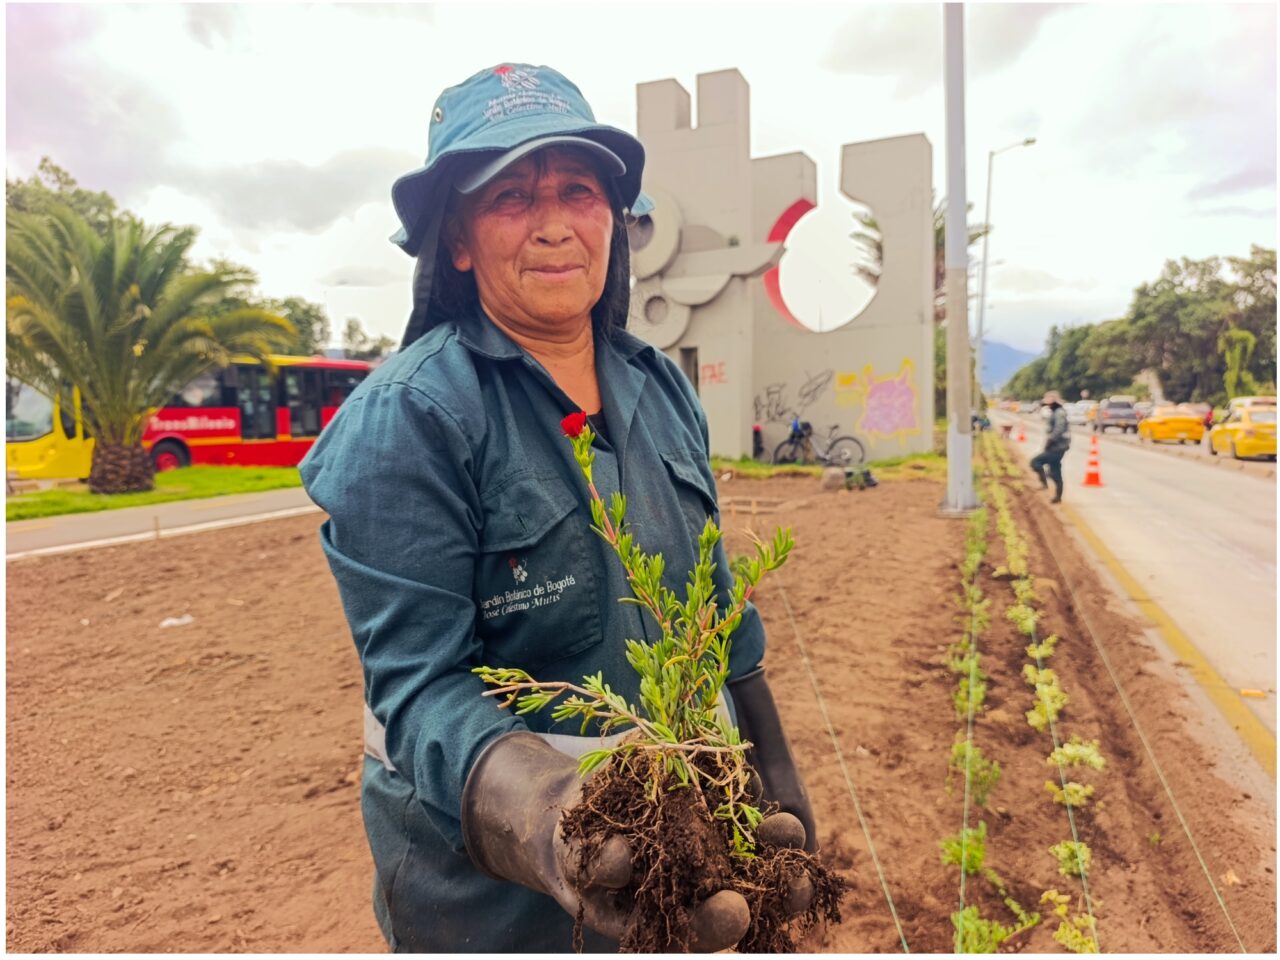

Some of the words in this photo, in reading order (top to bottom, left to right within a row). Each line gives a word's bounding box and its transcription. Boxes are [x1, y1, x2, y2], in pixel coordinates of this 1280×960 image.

[533, 584, 545, 597] de
[546, 575, 576, 594] Bogotá
[532, 593, 561, 608] Mutis
